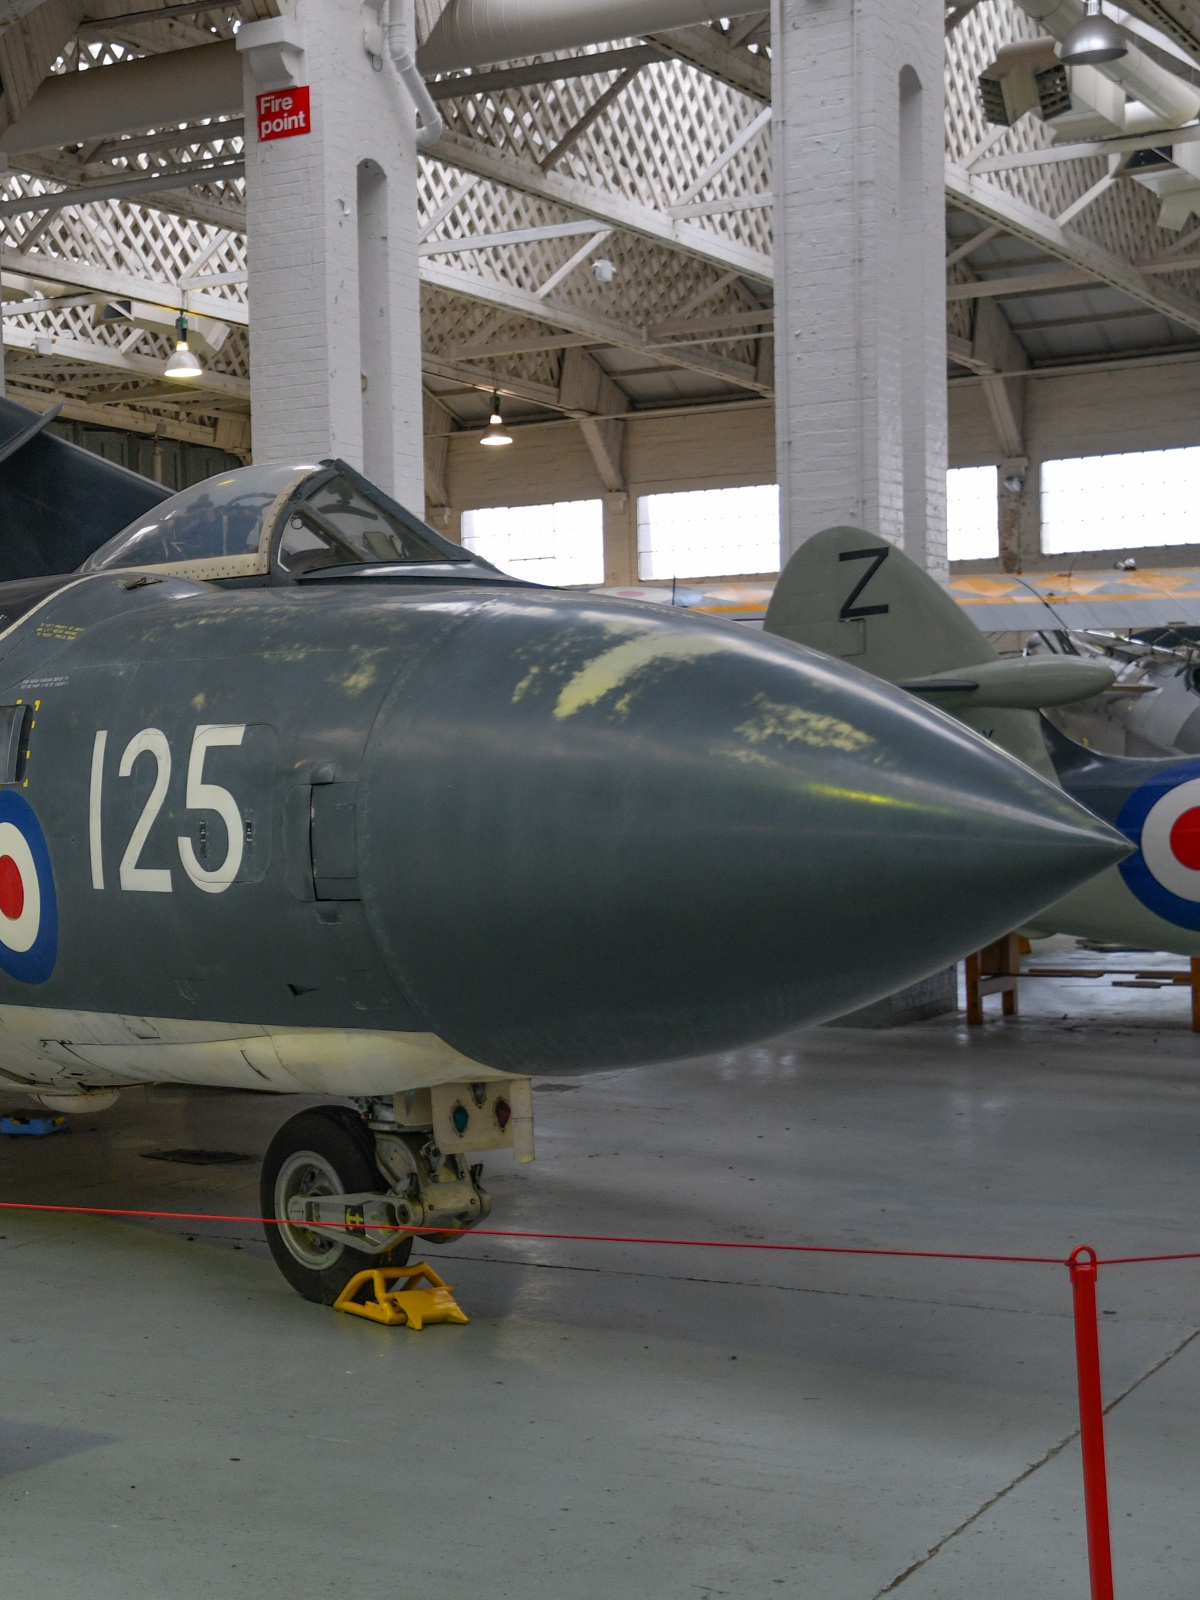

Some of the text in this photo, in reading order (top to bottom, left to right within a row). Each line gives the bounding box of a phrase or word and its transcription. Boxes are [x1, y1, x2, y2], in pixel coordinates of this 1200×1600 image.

[260, 95, 293, 115] Fire
[261, 110, 306, 138] point
[839, 546, 889, 619] Z
[89, 723, 246, 893] 125
